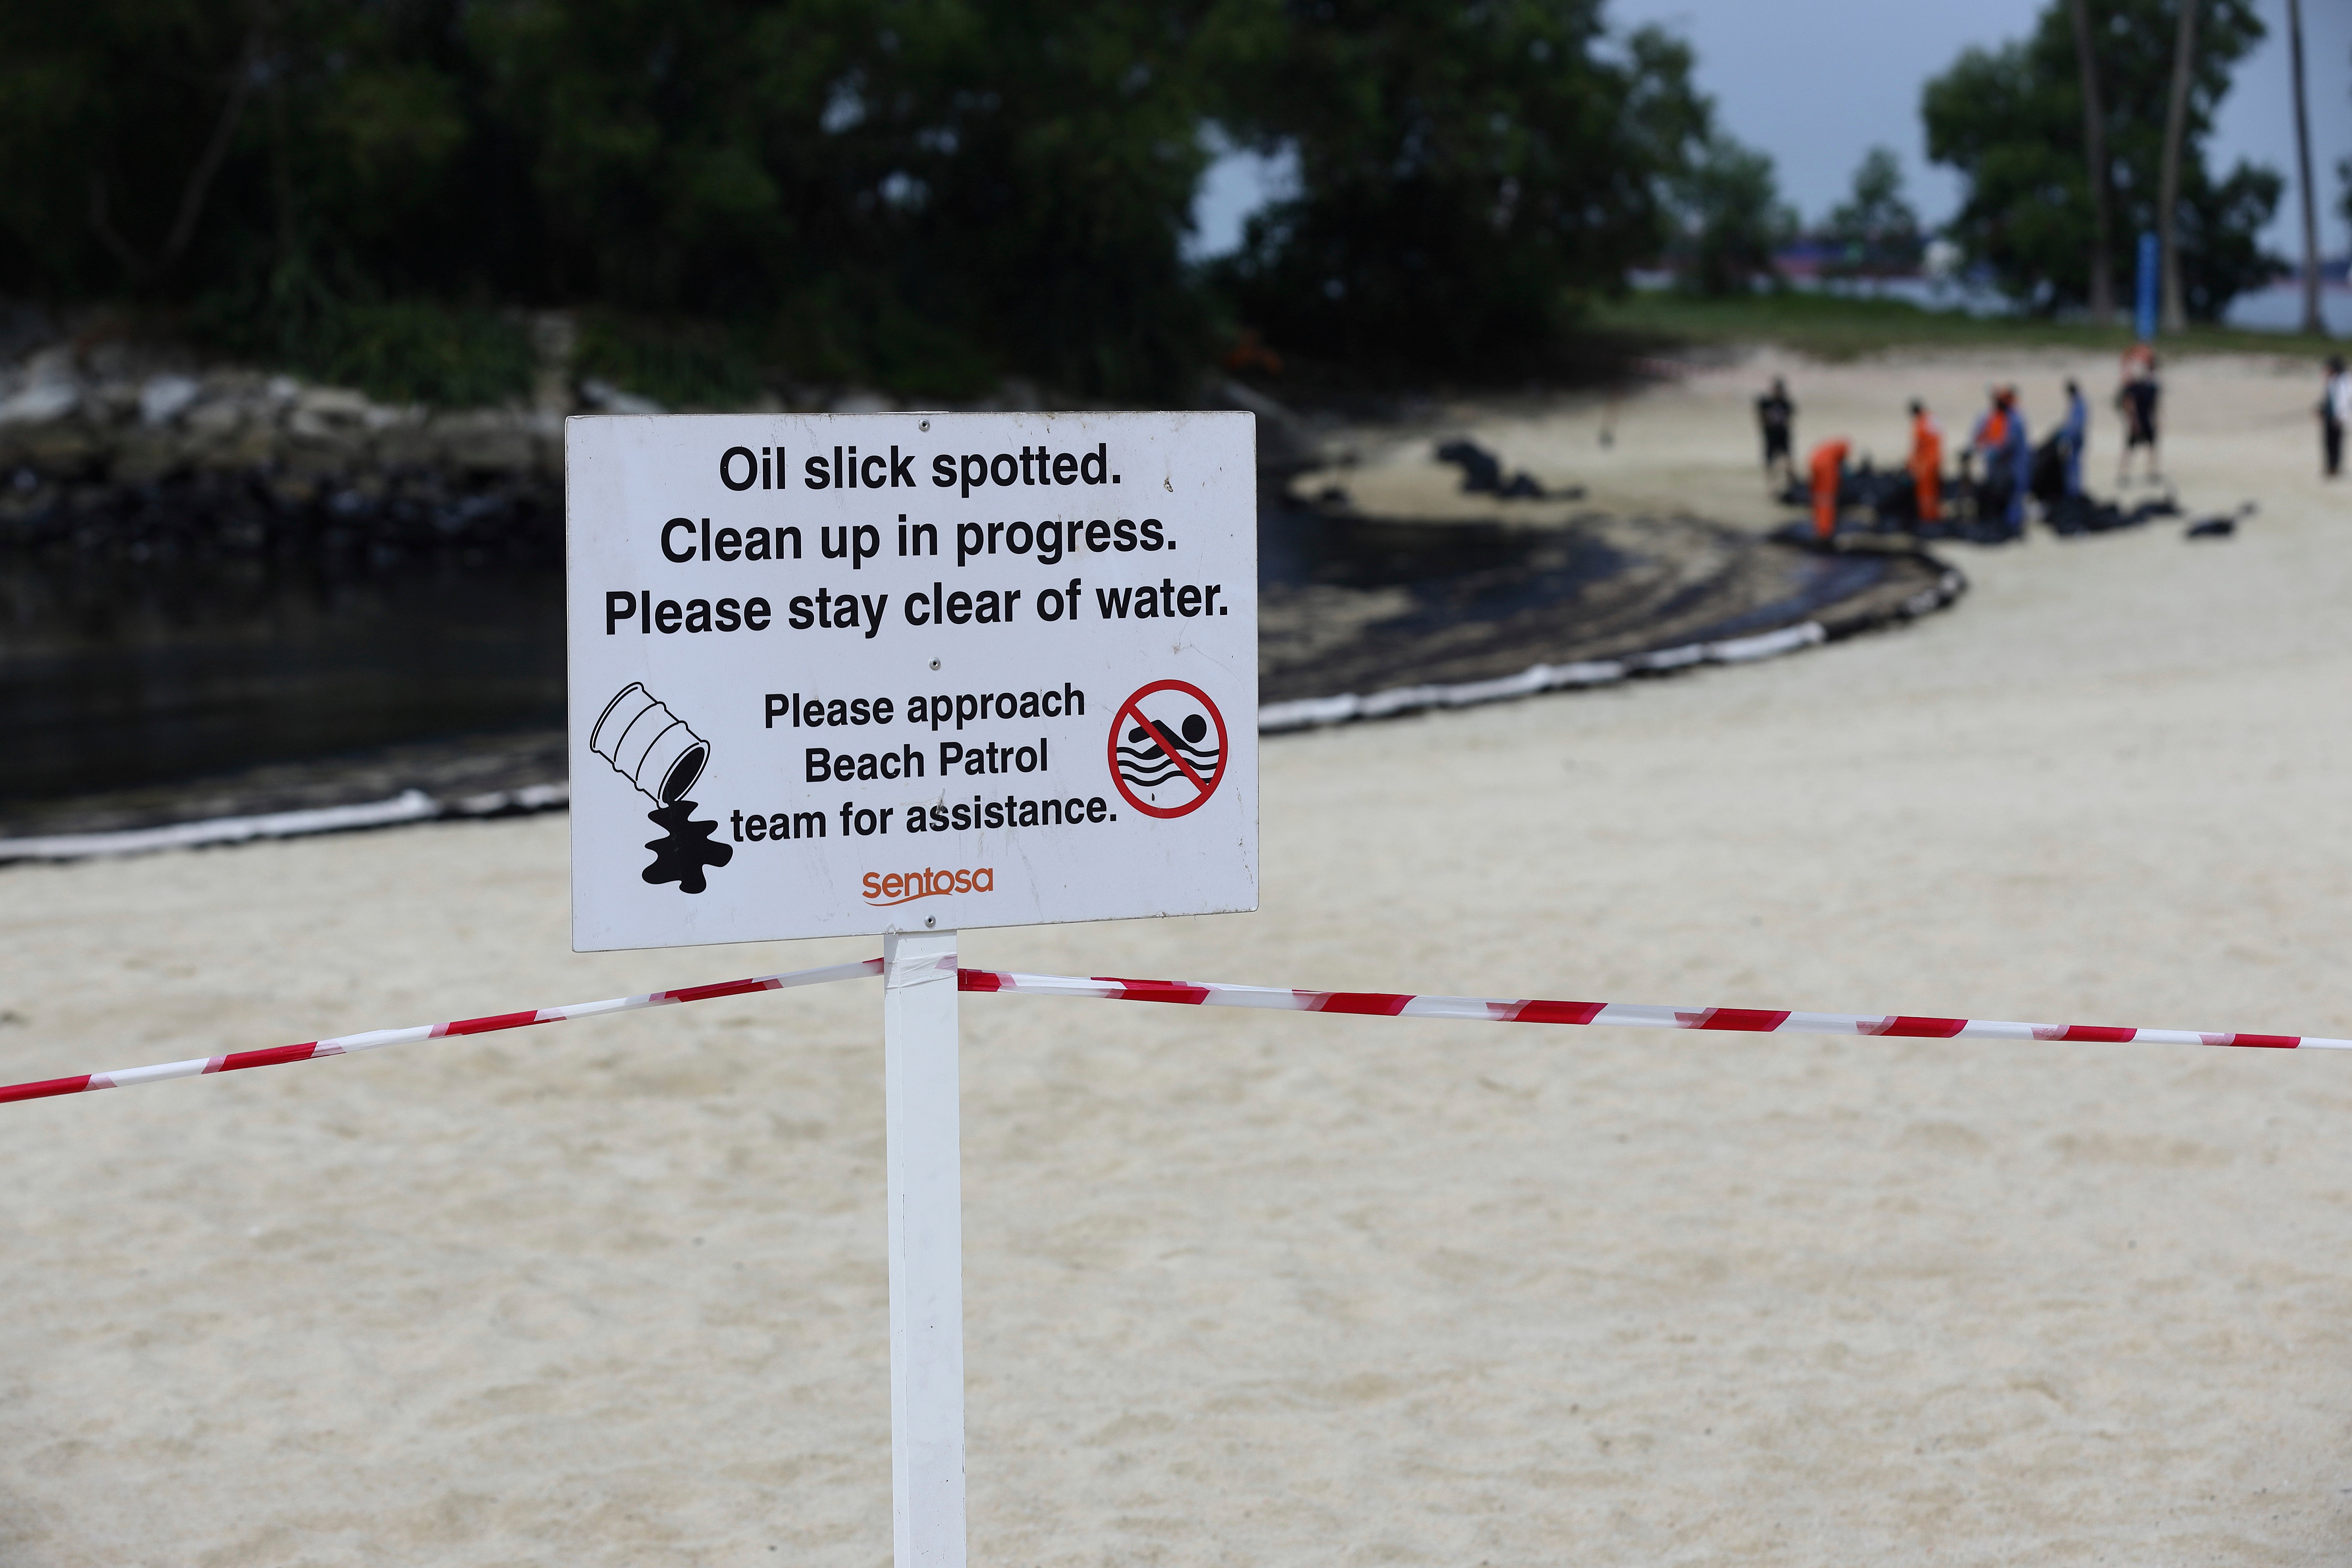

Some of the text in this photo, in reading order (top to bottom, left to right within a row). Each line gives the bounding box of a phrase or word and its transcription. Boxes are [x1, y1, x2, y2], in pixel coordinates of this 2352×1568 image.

[720, 443, 1120, 498] Oil slick spotted.
[661, 514, 1176, 570] Clean up in progress.
[606, 578, 1228, 639] Please stay clear of water.
[765, 682, 1084, 731] Please approach
[806, 738, 1047, 783] Beach Patrol
[730, 795, 1117, 842] team for assistance.
[862, 867, 993, 899] sentosa
